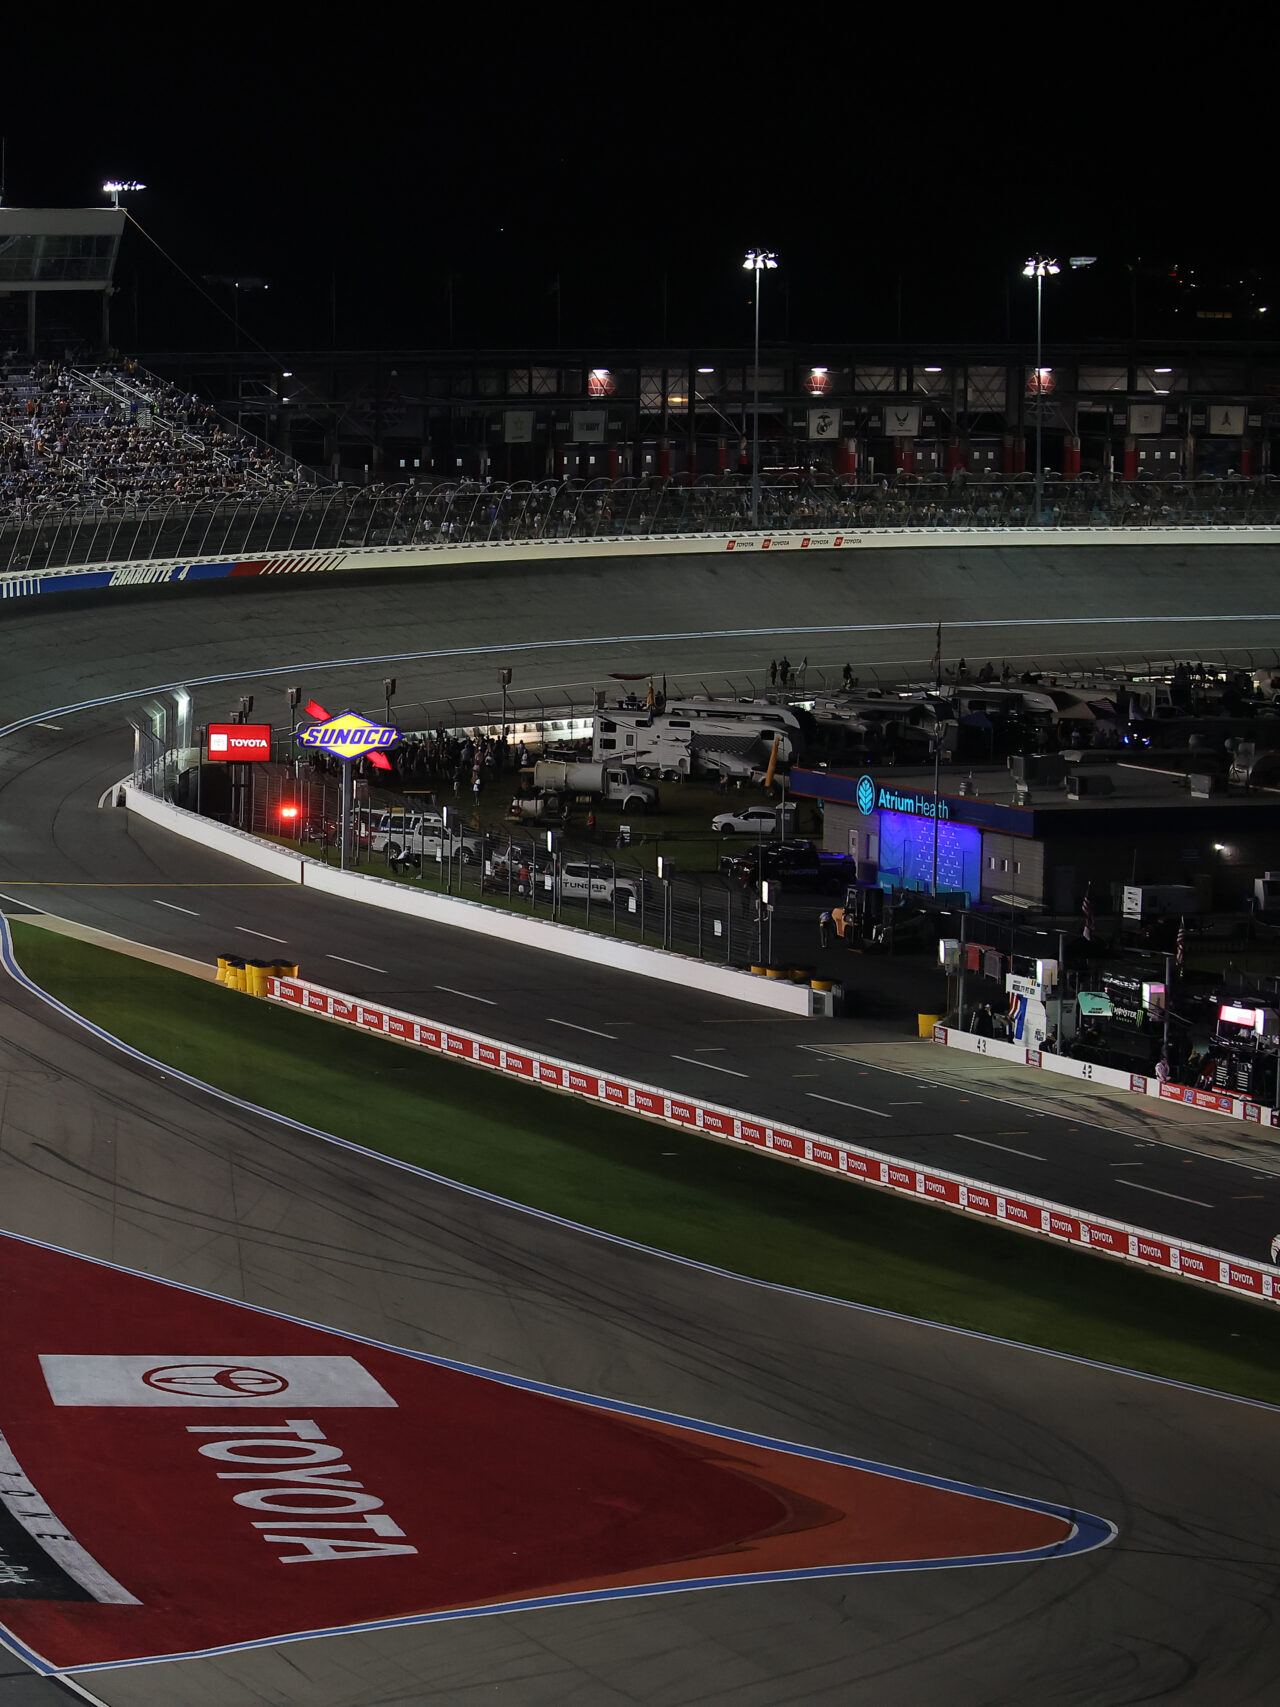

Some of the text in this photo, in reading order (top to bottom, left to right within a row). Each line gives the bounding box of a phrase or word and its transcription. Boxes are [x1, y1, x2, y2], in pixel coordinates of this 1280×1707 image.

[109, 564, 190, 586] CHARLOTTE 4
[230, 738, 268, 748] TOYOTA
[306, 728, 395, 745] SUNOCO
[878, 788, 949, 819] Atrium Heath
[281, 986, 294, 997] TOYOTA
[309, 996, 323, 1007] TOYOTA
[334, 1004, 348, 1015] TOYOTA
[364, 1013, 378, 1024] TOYOTA
[390, 1021, 404, 1032] TOYOTA
[421, 1030, 436, 1041] TOYOTA
[448, 1039, 463, 1050] TOYOTA
[976, 1038, 987, 1052] 43
[480, 1049, 494, 1060] TOYOTA
[507, 1057, 522, 1069] TOYOTA
[540, 1068, 556, 1079] TOYOTA
[1082, 1064, 1093, 1078] 42
[571, 1076, 587, 1088] TOYOTA
[607, 1087, 622, 1098] TOYOTA
[636, 1095, 652, 1107] TOYOTA
[672, 1106, 689, 1118] TOYOTA
[704, 1115, 722, 1128] TOYOTA
[742, 1127, 760, 1139] TOYOTA
[774, 1136, 793, 1149] TOYOTA
[814, 1148, 832, 1161] TOYOTA
[848, 1158, 867, 1172] TOYOTA
[889, 1170, 909, 1184] TOYOTA
[926, 1181, 946, 1194] TOYOTA
[969, 1194, 989, 1207] TOYOTA
[1007, 1205, 1027, 1219] TOYOTA
[1051, 1219, 1072, 1233] TOYOTA
[1091, 1230, 1113, 1244] TOYOTA
[1140, 1244, 1161, 1258] TOYOTA
[1181, 1256, 1204, 1271] TOYOTA
[1231, 1271, 1254, 1285] TOYOTA
[185, 1419, 419, 1564] TOYOTA
